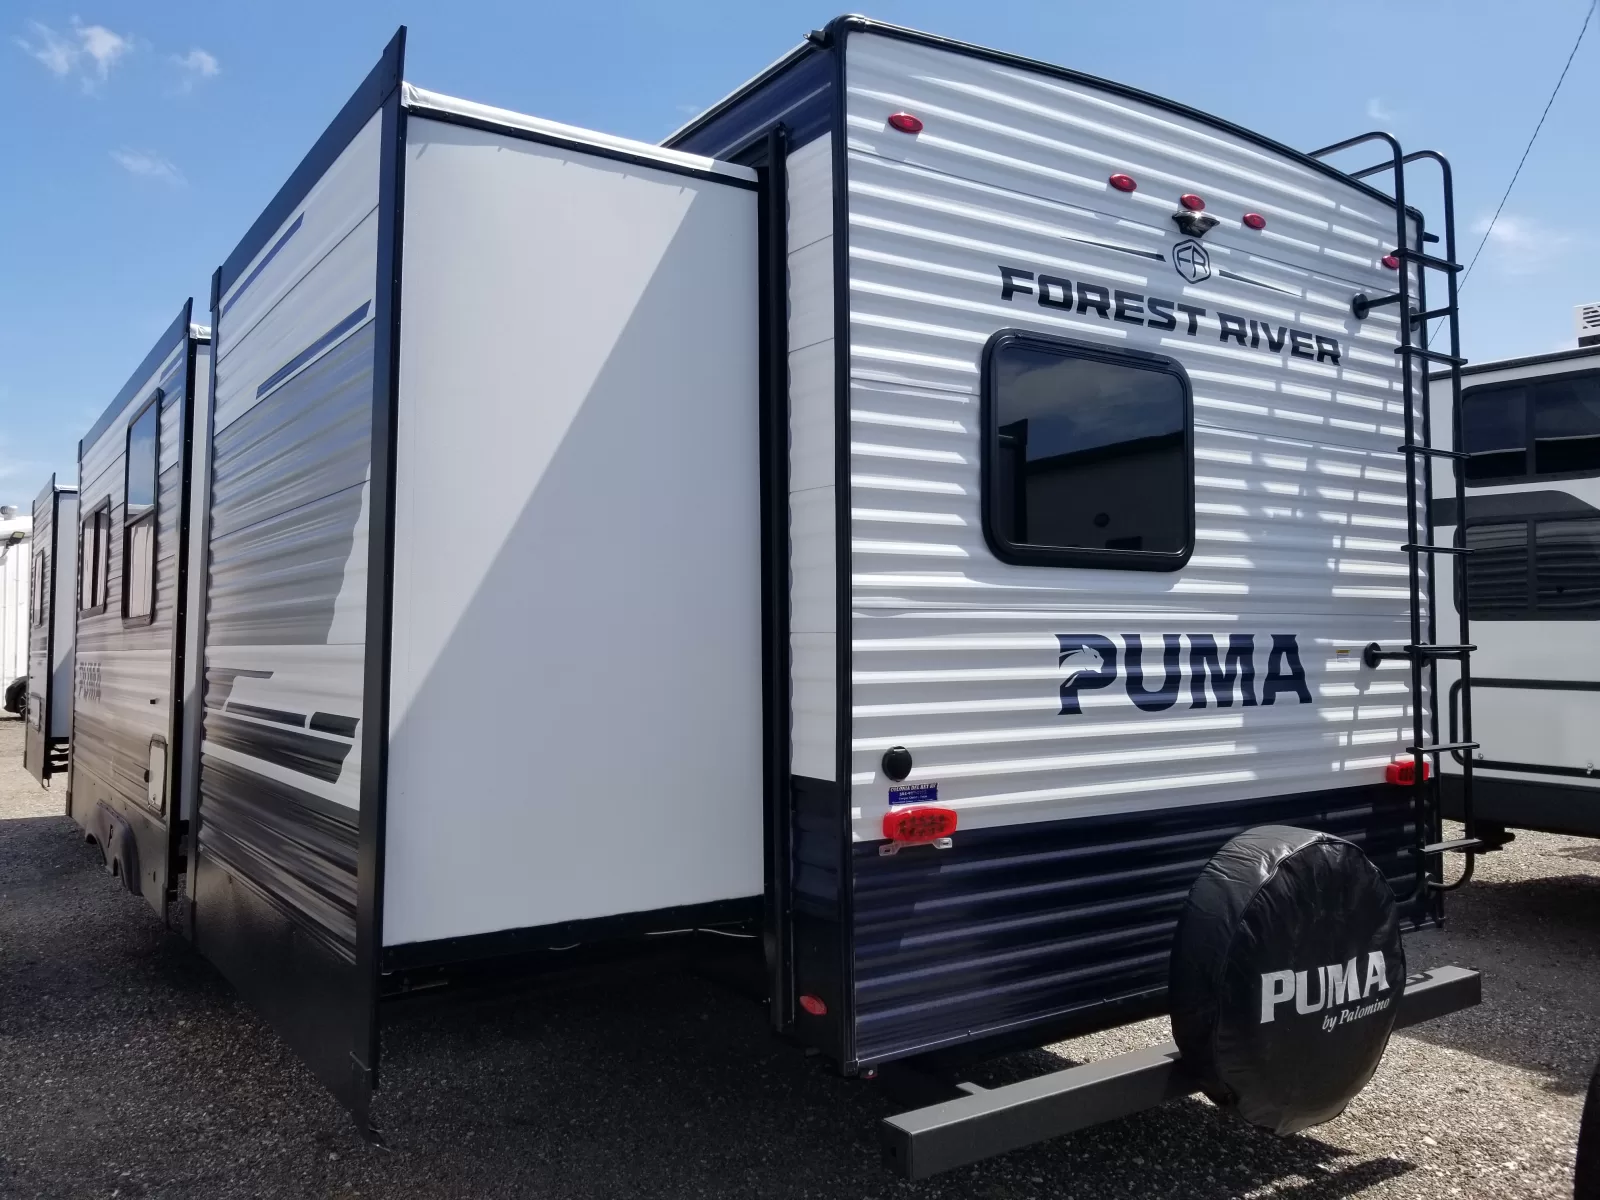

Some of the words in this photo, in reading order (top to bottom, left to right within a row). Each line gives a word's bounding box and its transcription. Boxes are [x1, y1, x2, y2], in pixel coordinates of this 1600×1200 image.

[998, 265, 1206, 336] FOREST
[1216, 311, 1342, 366] RIVER
[1054, 633, 1313, 715] PUMA
[1260, 950, 1390, 1024] PUMA
[1322, 1015, 1336, 1033] by
[1338, 997, 1391, 1025] Palomino
